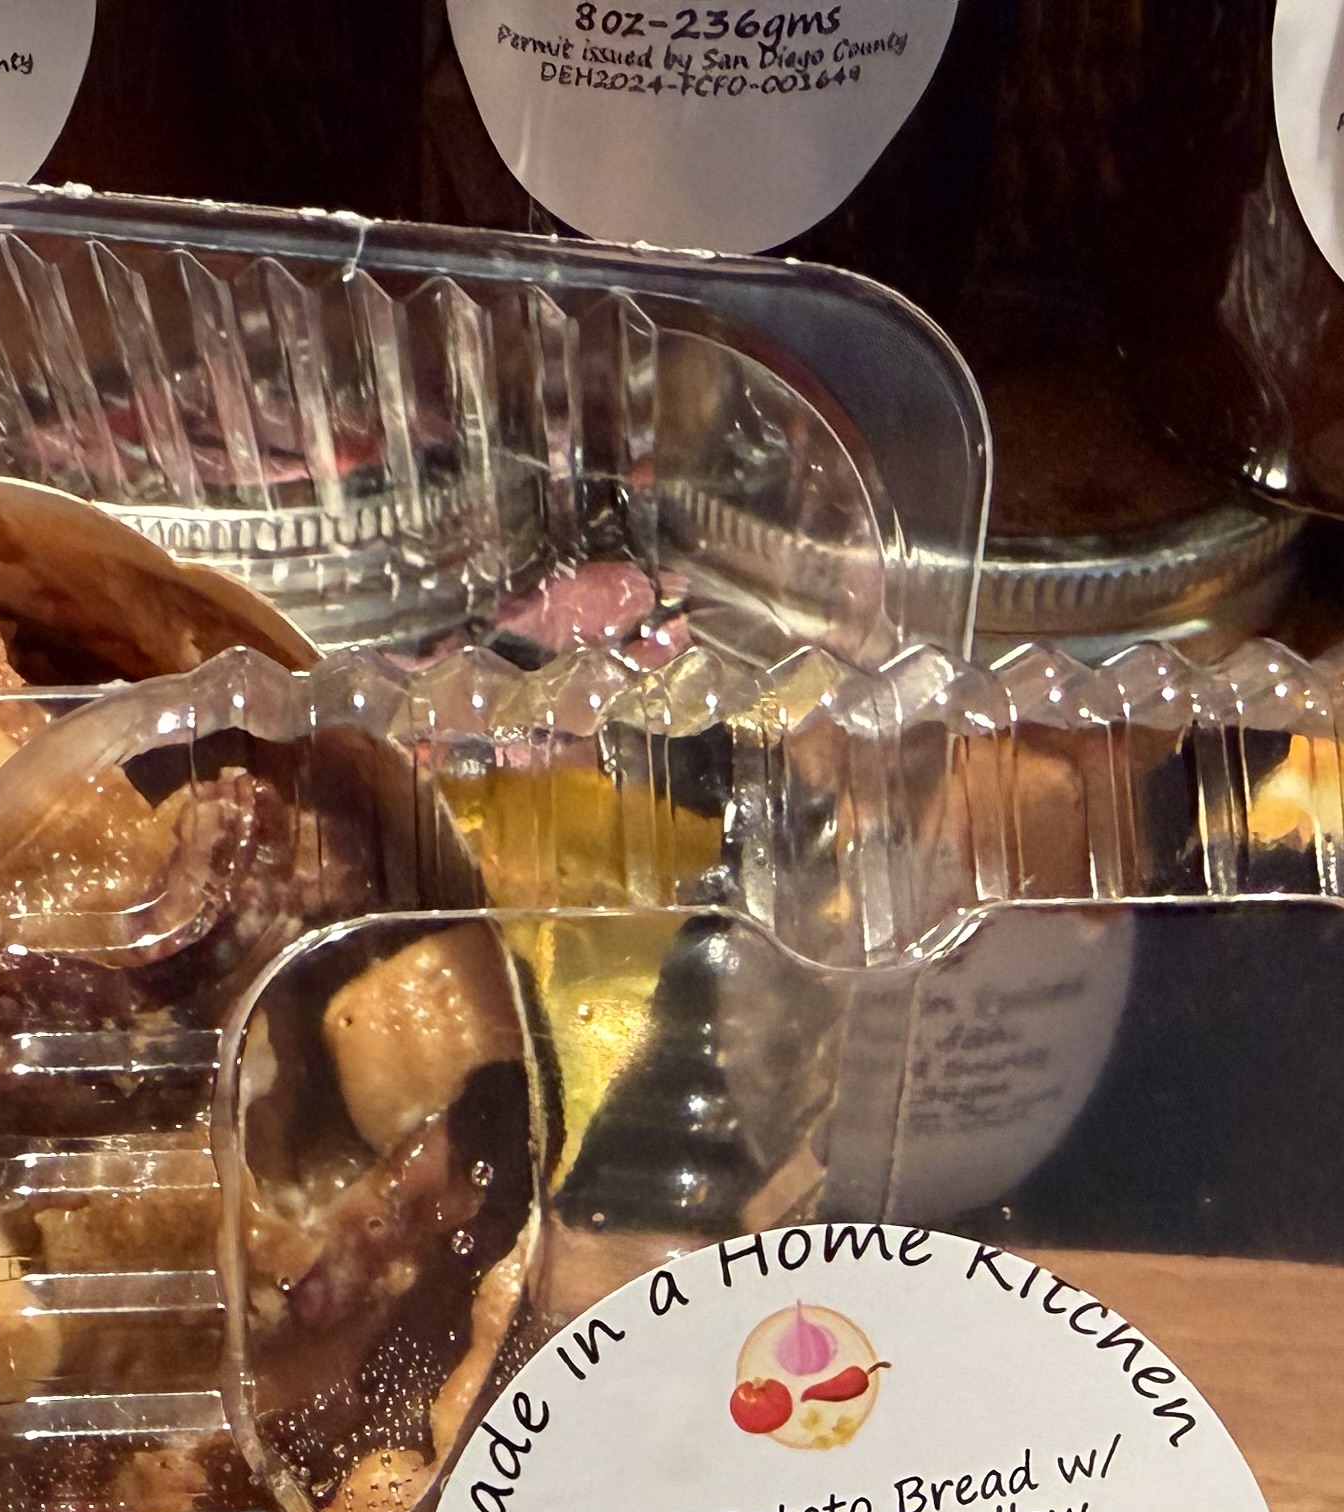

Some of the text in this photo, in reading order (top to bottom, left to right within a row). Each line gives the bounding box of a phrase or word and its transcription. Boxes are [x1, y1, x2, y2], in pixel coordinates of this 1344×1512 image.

[575, 2, 841, 48] 8oz-236gms
[664, 45, 692, 74] by
[702, 48, 749, 70] San
[649, 1270, 689, 1315] a
[718, 1223, 932, 1287] Home
[1057, 1433, 1121, 1483] w/
